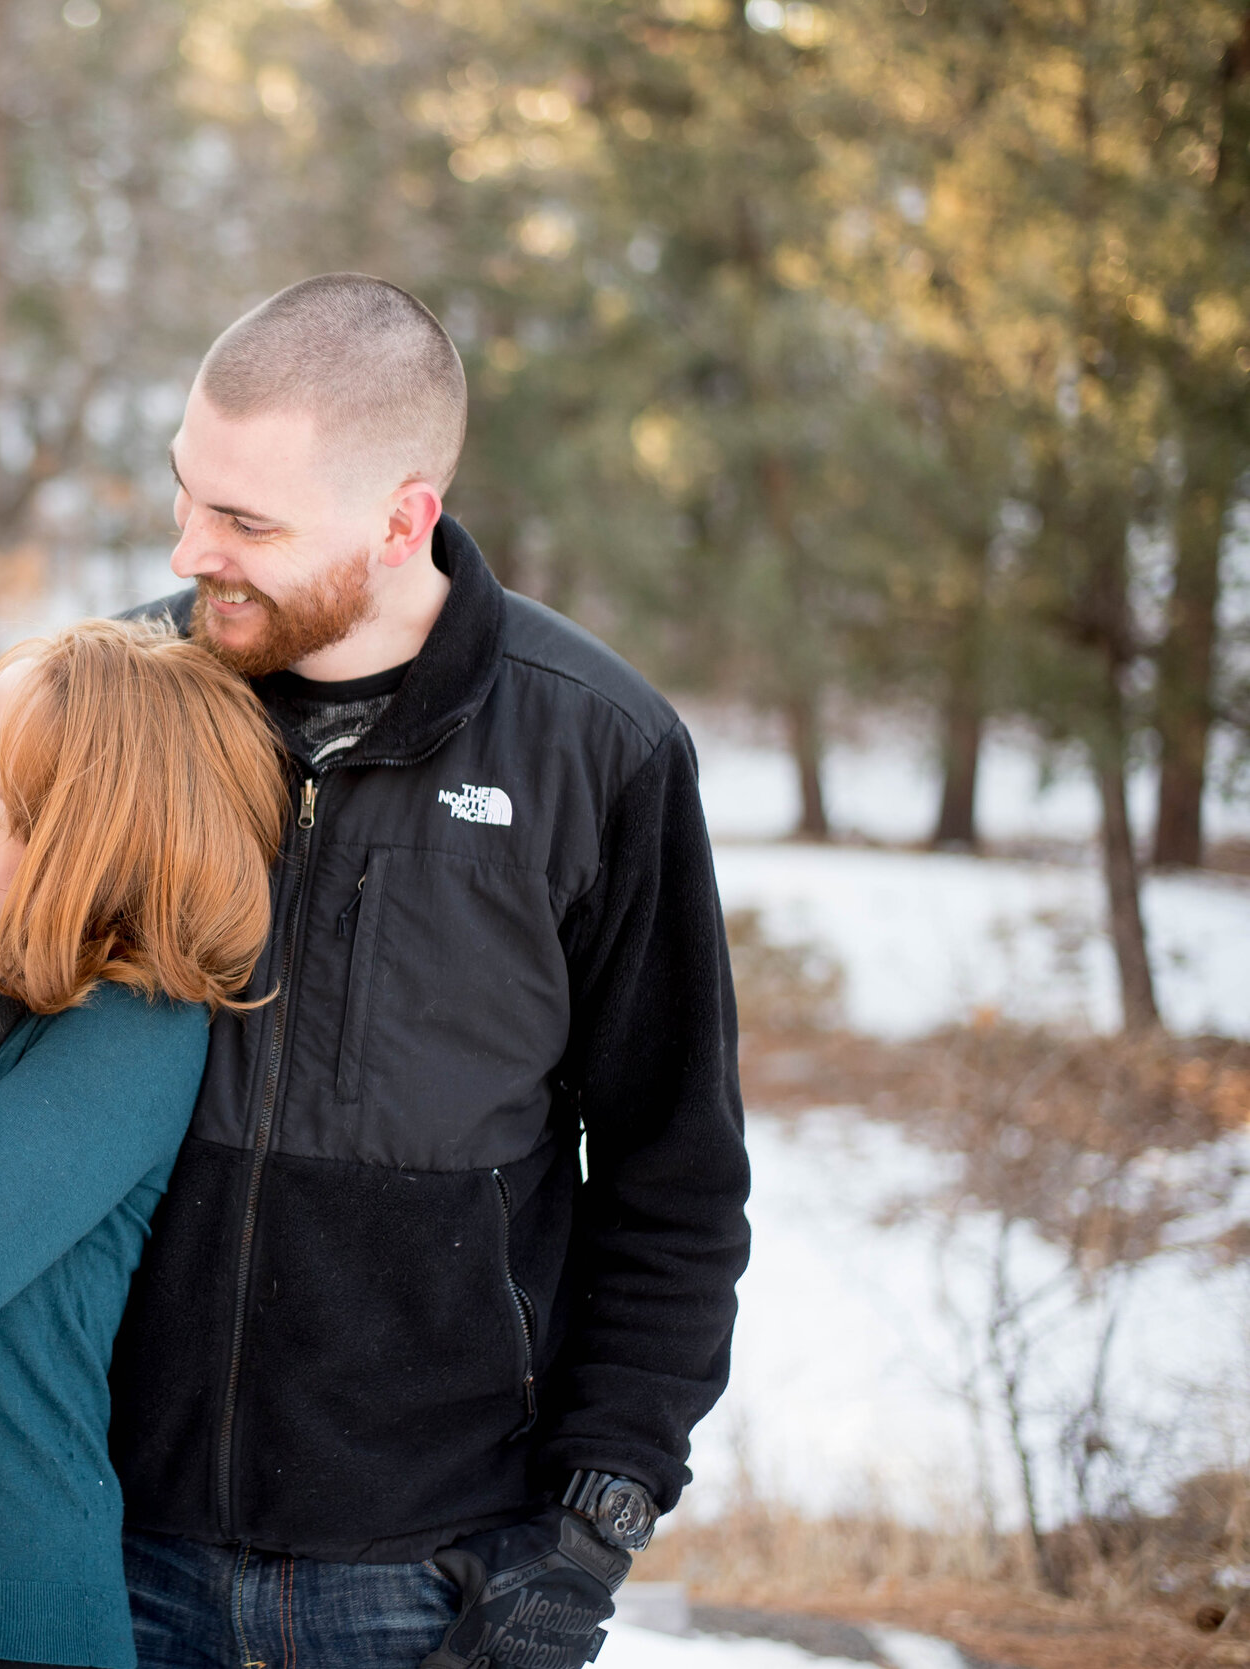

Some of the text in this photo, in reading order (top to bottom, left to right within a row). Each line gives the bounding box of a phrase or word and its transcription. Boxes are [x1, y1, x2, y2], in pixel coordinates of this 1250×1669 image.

[437, 789, 489, 812] NORTH
[461, 783, 491, 799] THE
[450, 804, 487, 823] FACE
[489, 1562, 548, 1596] INSULATED
